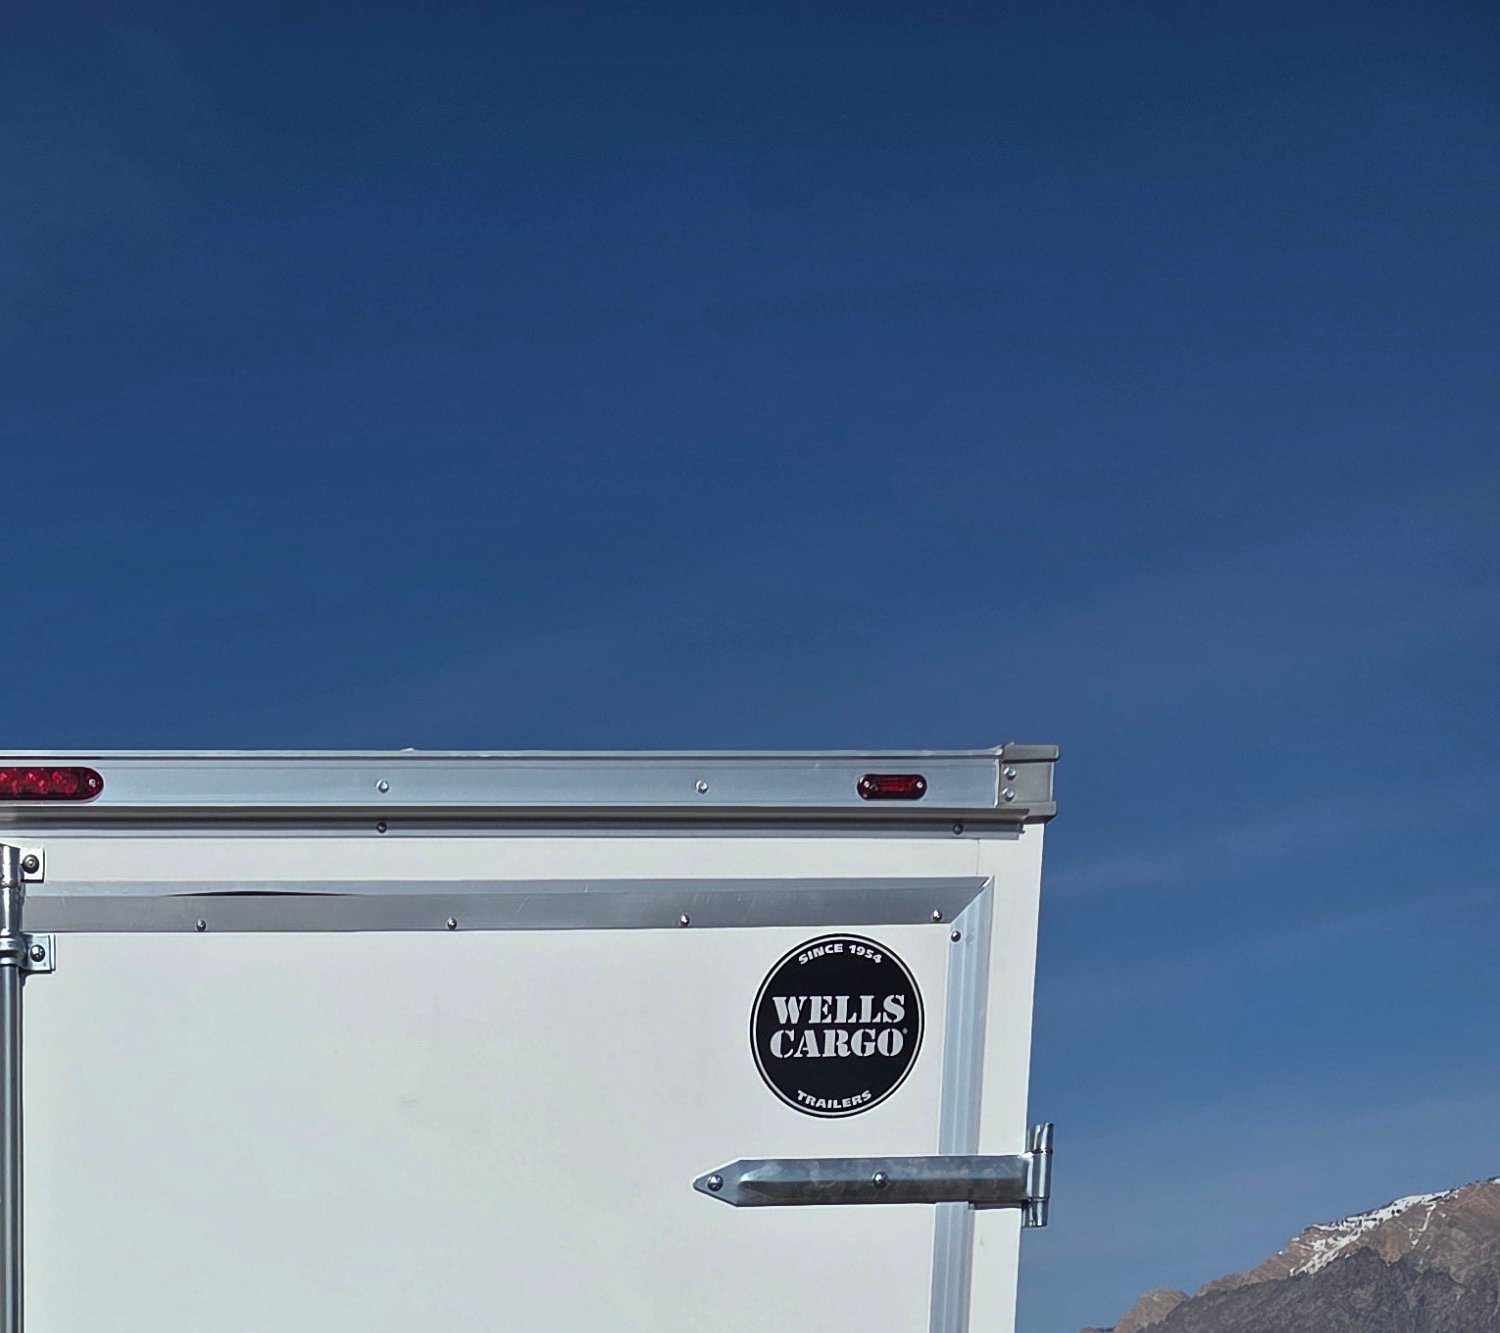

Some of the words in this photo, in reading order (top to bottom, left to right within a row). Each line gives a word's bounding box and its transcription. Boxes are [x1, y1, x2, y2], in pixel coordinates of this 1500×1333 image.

[798, 943, 844, 965] SINCE
[848, 944, 882, 964] 1954
[772, 994, 905, 1024] WELLS
[769, 1028, 904, 1058] CARGO
[797, 1090, 872, 1109] TRAILERS
